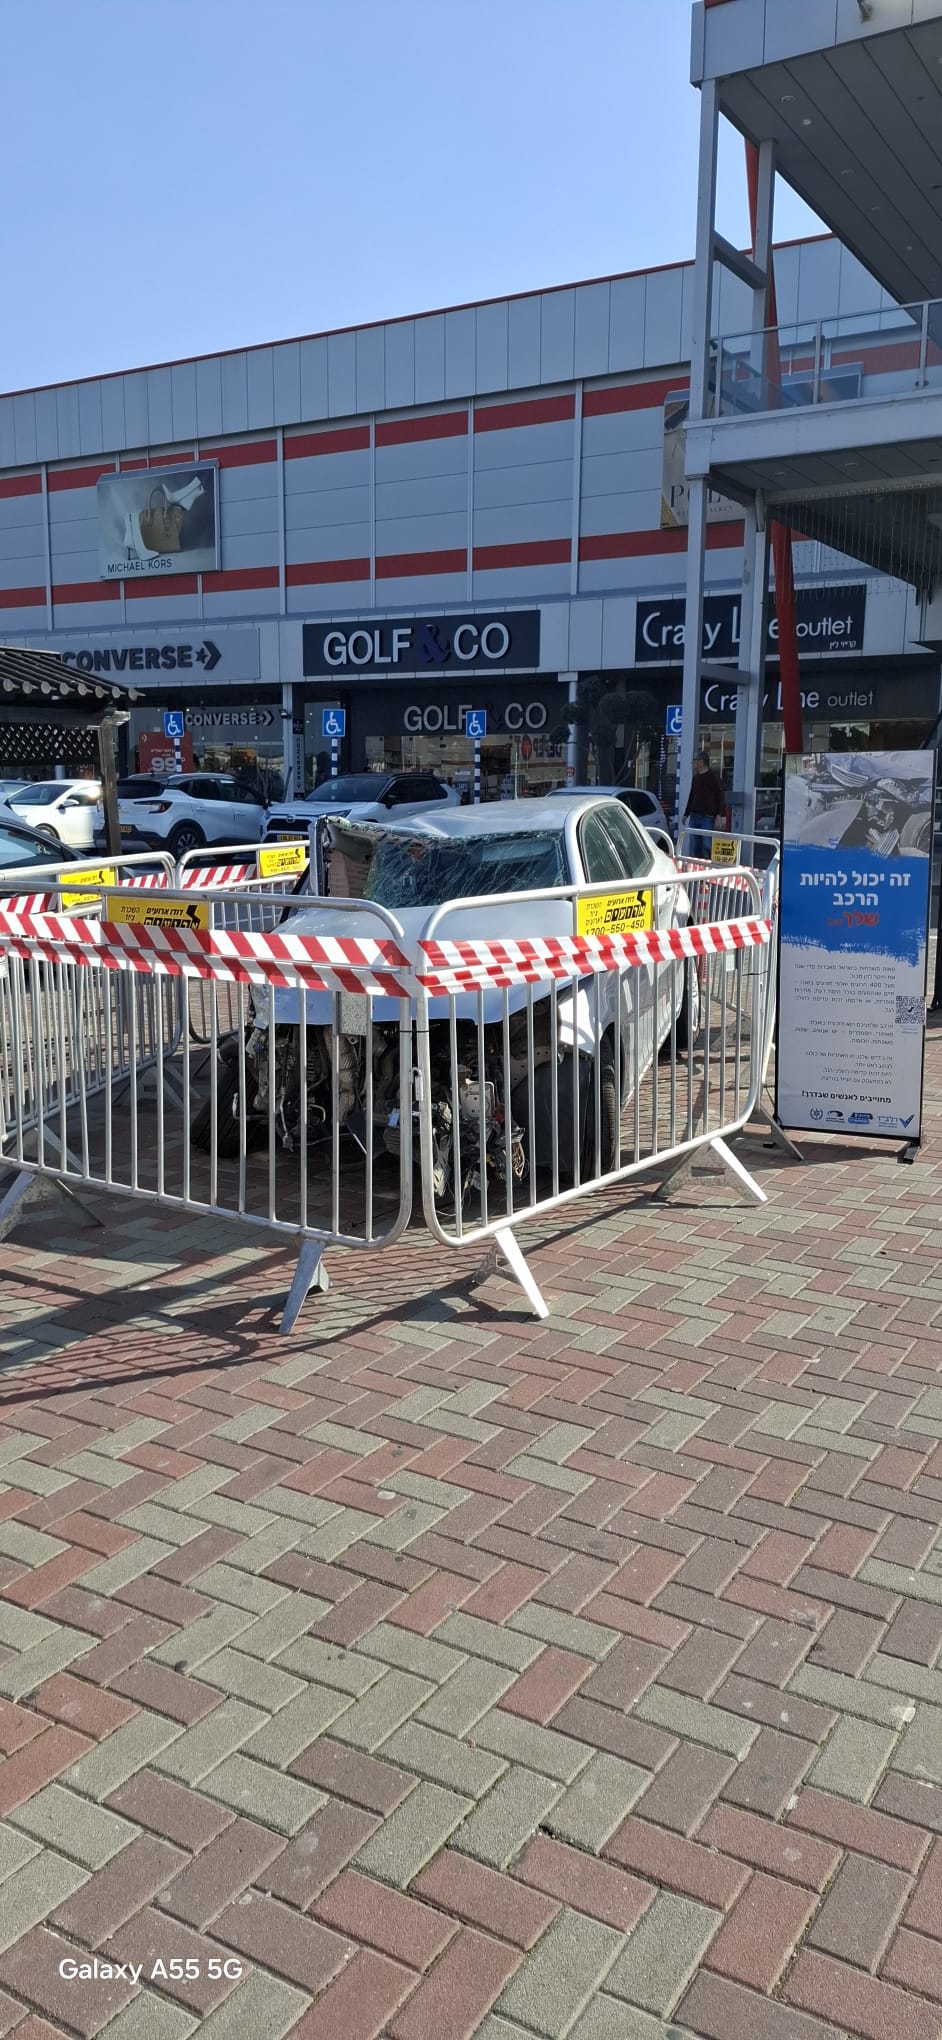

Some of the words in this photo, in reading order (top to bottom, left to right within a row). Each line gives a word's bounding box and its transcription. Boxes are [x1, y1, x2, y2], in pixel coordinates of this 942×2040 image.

[108, 562, 144, 573] MICHAEL
[148, 559, 172, 568] KORS
[642, 612, 722, 650] Cray
[732, 606, 779, 642] Le
[796, 616, 854, 638] outlet
[324, 628, 412, 666] GOLF
[416, 624, 450, 663] &
[454, 622, 510, 660] CO
[777, 682, 820, 710] Lne
[828, 691, 874, 707] outlet
[185, 712, 257, 726] CONVERSE
[404, 704, 472, 731] GOLF
[505, 702, 546, 729] CO
[800, 870, 848, 886] להיות
[852, 870, 884, 886] יכול
[890, 873, 912, 886] זה
[833, 892, 878, 906] הרכב
[586, 919, 645, 936] 1700-550-450
[802, 1090, 829, 1098] שבדרך!
[830, 1093, 858, 1101] לאנשים
[860, 1095, 892, 1104] מחוייבים
